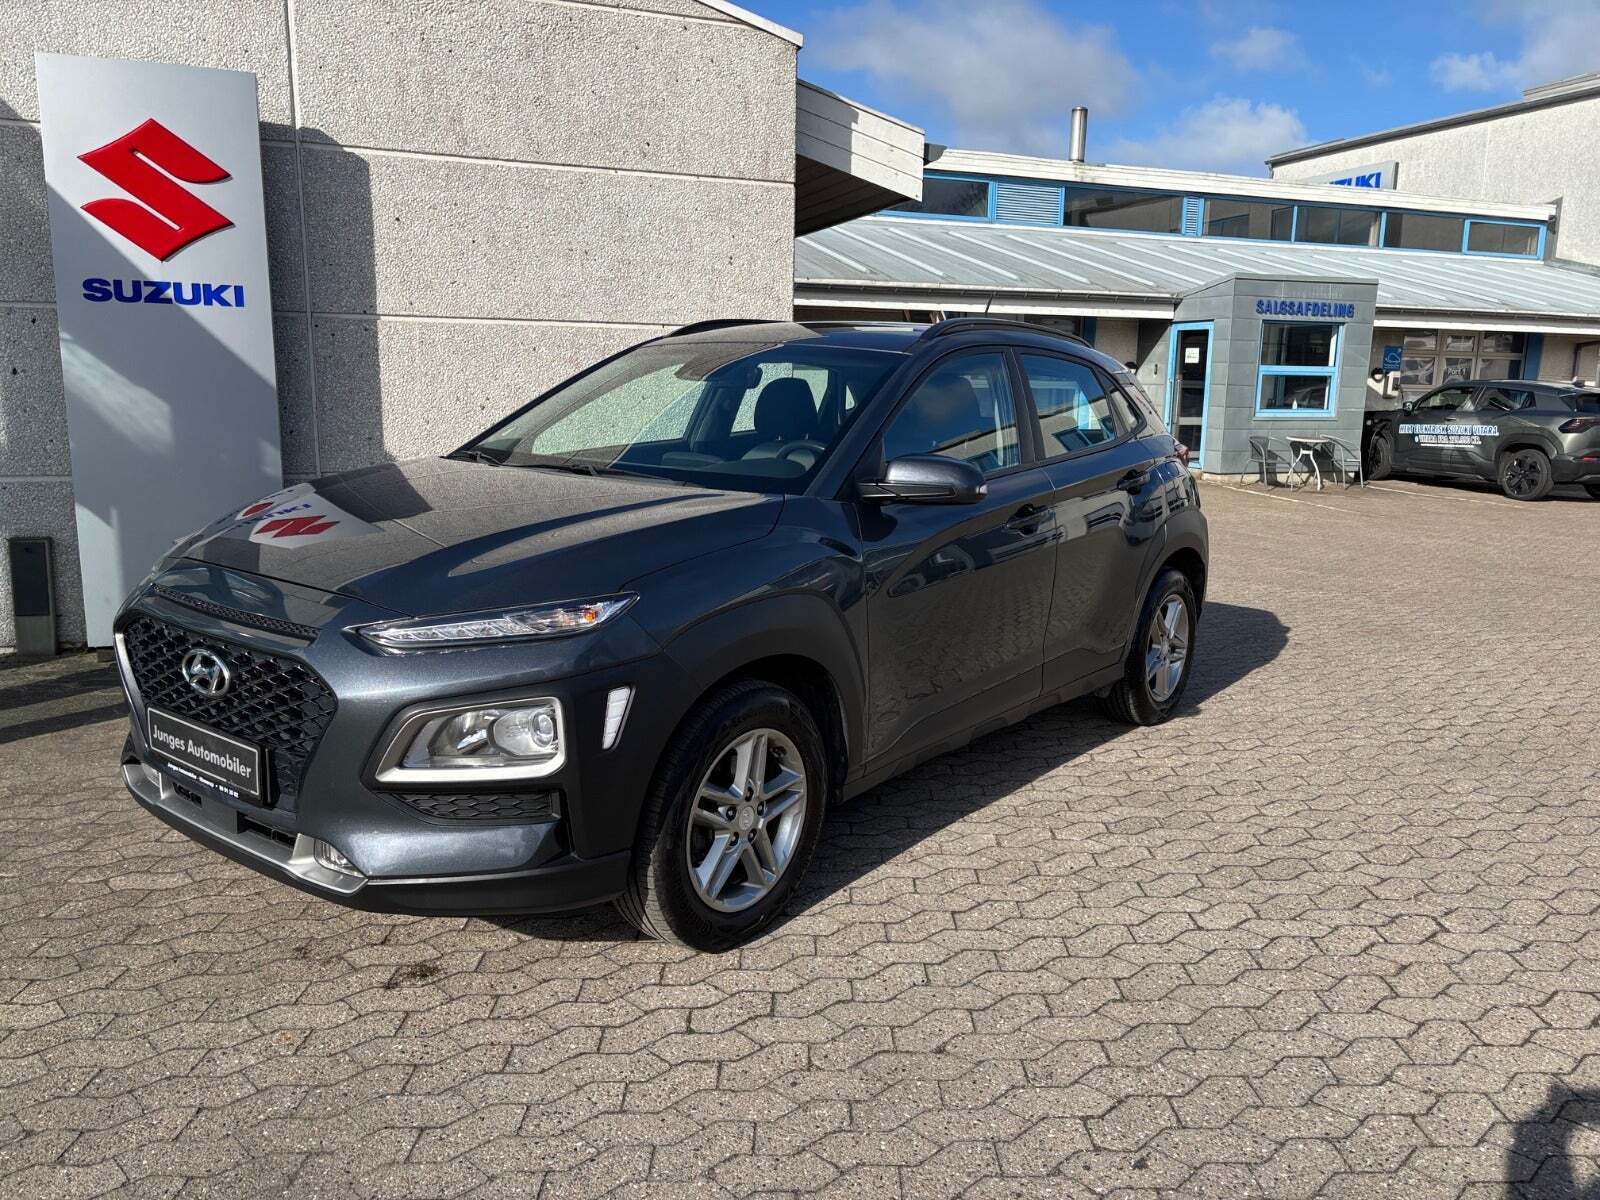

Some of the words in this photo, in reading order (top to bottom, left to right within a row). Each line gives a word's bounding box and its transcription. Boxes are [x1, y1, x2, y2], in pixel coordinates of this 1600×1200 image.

[82, 278, 244, 307] SUZUKI
[1256, 300, 1355, 318] SALGSAFDELING
[153, 725, 185, 750] Junges
[187, 740, 252, 778] Automobiler
